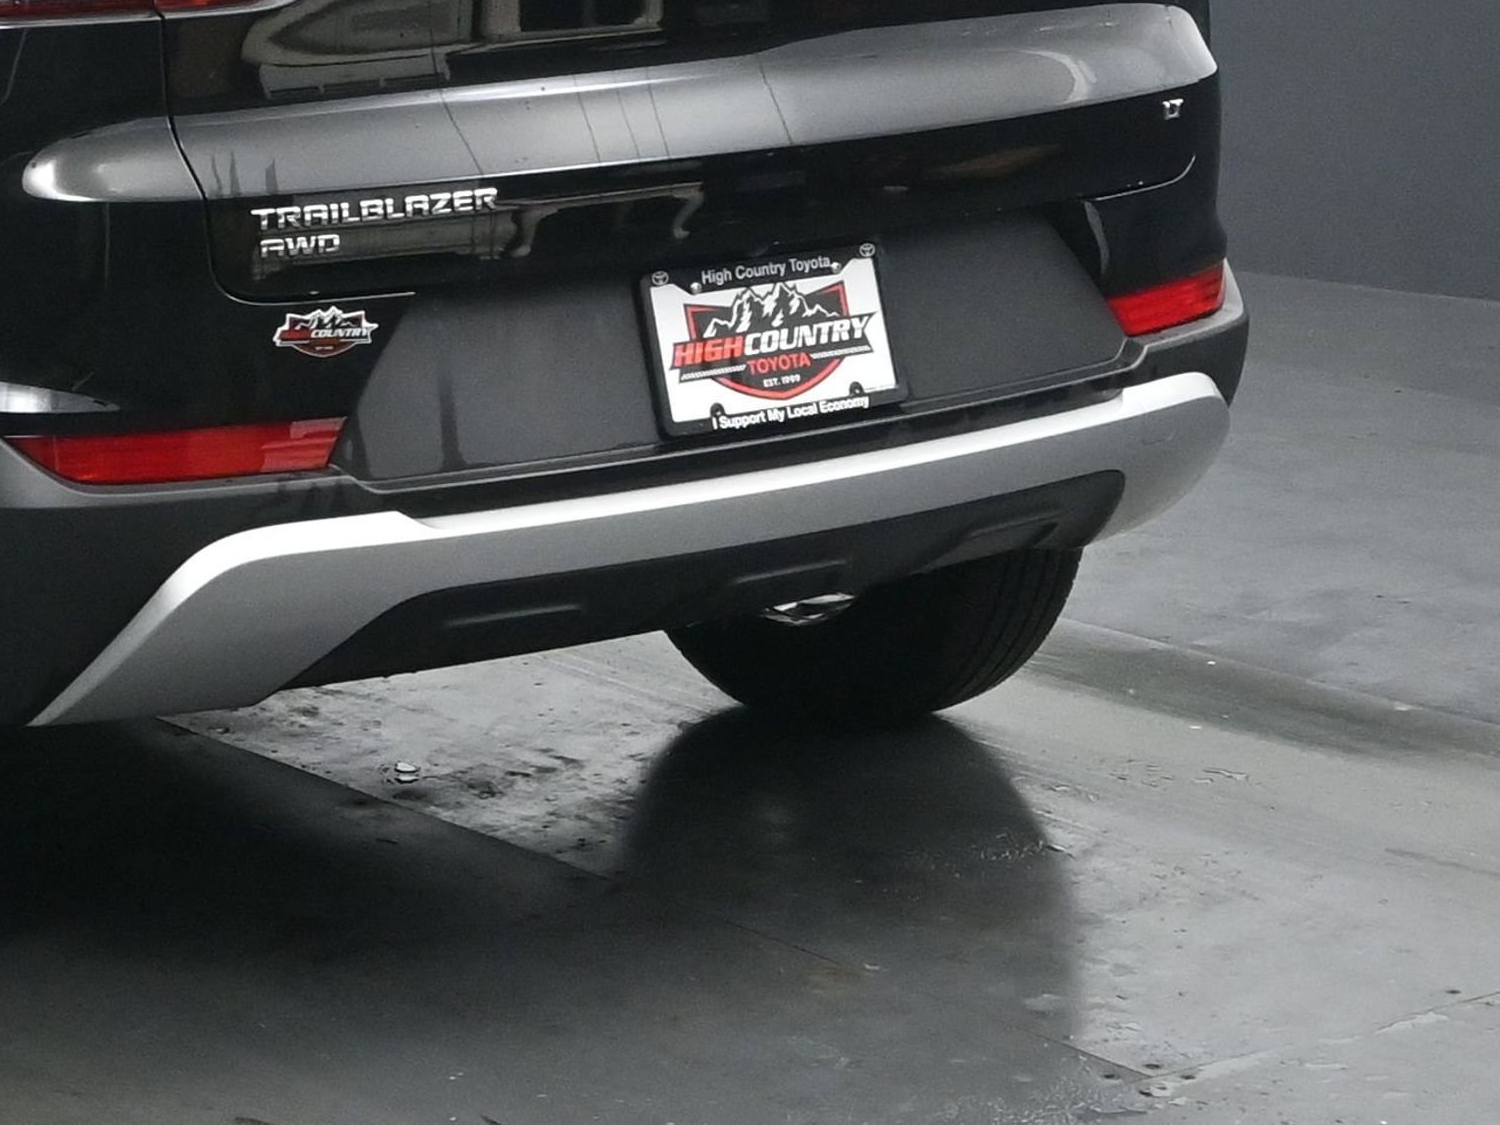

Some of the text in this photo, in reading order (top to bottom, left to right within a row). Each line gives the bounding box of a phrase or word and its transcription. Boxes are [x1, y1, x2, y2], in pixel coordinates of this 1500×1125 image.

[250, 187, 498, 231] TRAILBLAZER
[260, 234, 341, 258] AWD
[701, 255, 831, 286] High Country Toyota
[747, 351, 812, 375] TOYOTA
[712, 395, 870, 430] I Support My Local Economy
